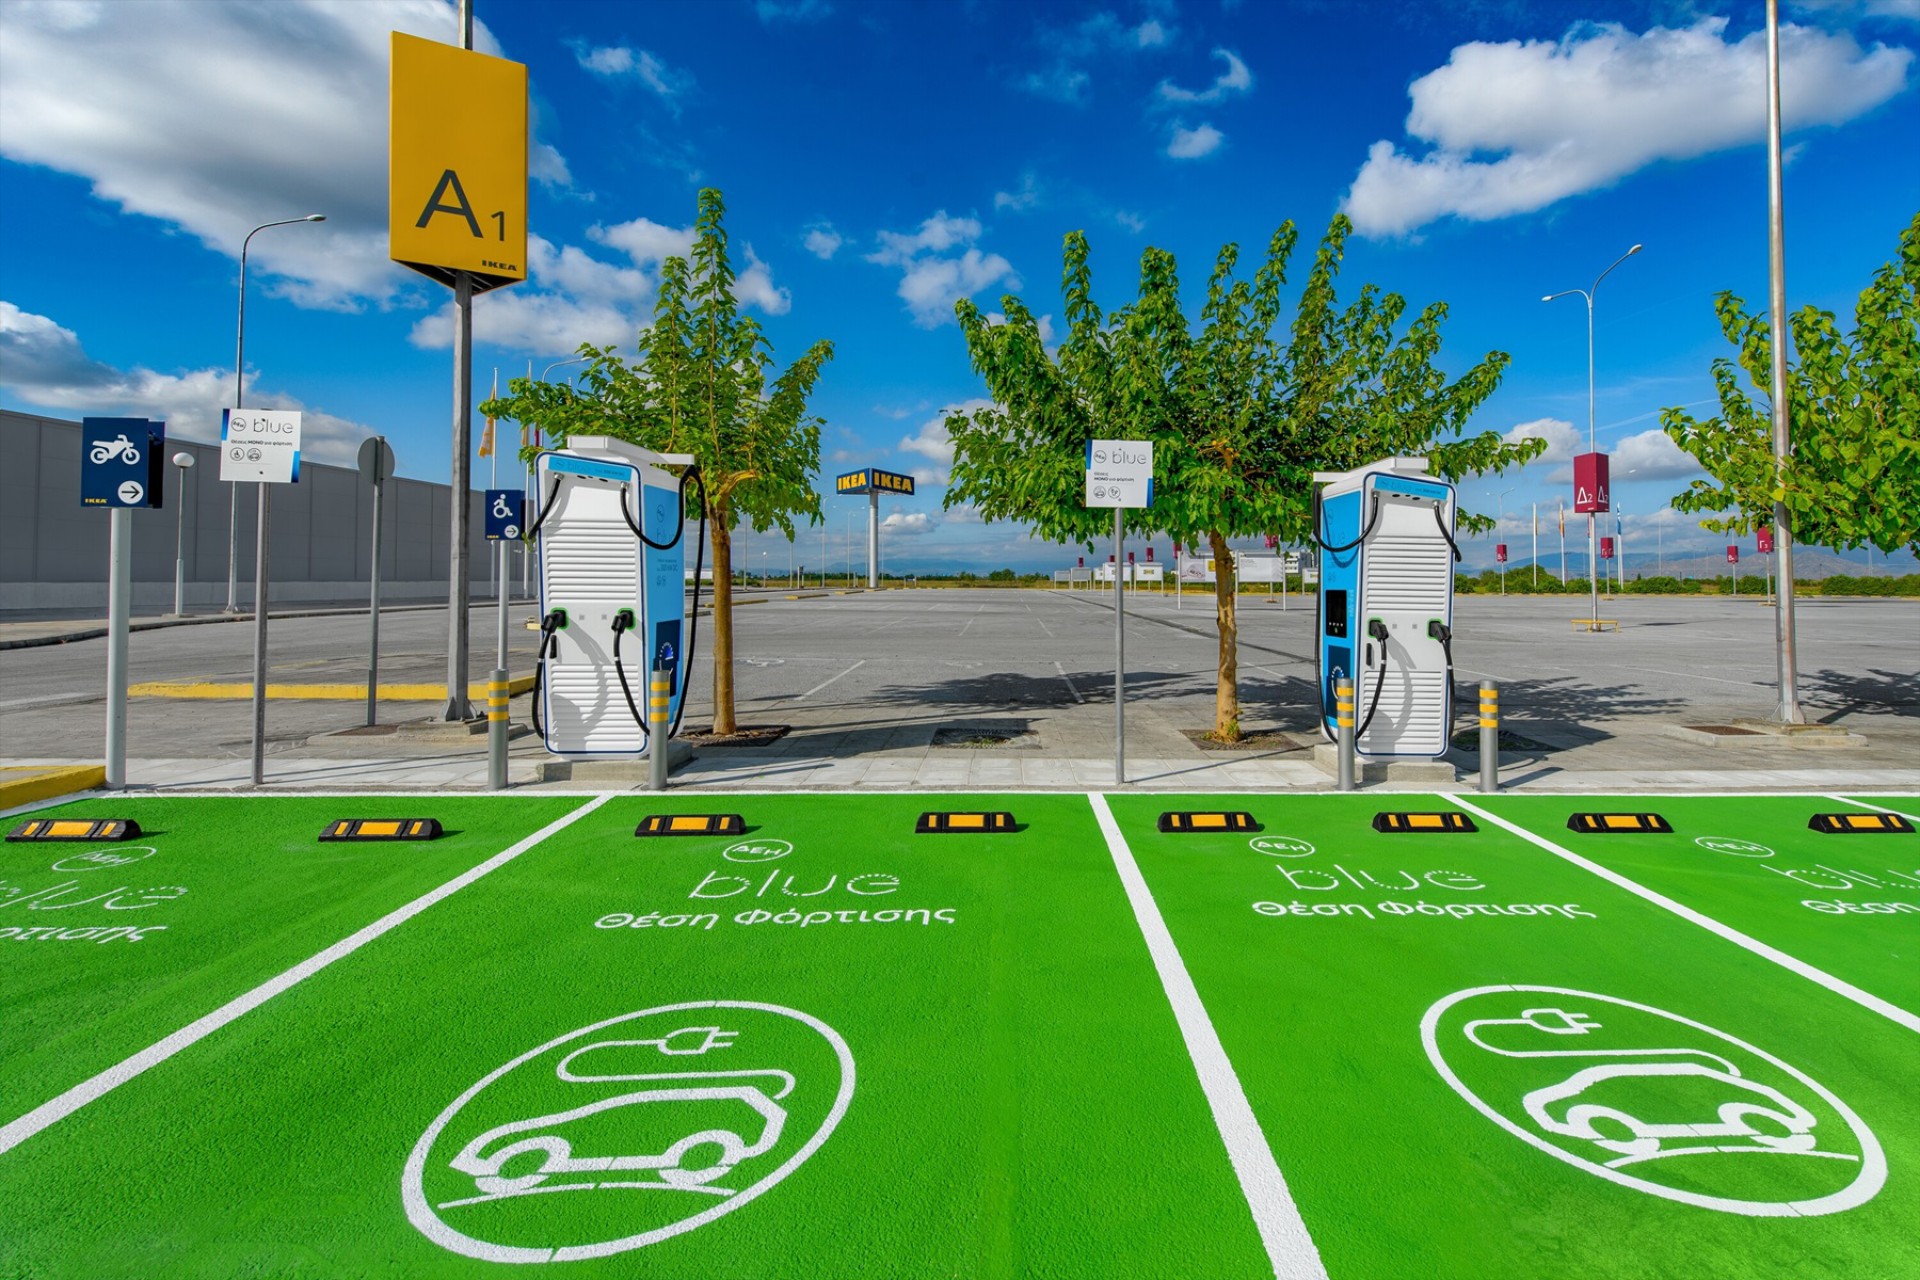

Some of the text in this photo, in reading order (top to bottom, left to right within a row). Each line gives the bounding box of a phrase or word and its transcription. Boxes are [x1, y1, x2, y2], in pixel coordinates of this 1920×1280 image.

[481, 259, 517, 271] IKEA
[253, 418, 293, 434] blue
[1112, 450, 1147, 465] blue
[837, 472, 867, 491] IKEA
[874, 472, 912, 492] IKEA
[732, 845, 783, 856] ΔΕΗ
[1257, 841, 1308, 852] ΔΕΗ
[688, 869, 901, 899] blue
[1275, 864, 1486, 890] blue
[1760, 863, 1920, 890] blu
[594, 907, 957, 930] Θέση Φόρτισης
[1251, 900, 1598, 919] Θέση Φόρτισης
